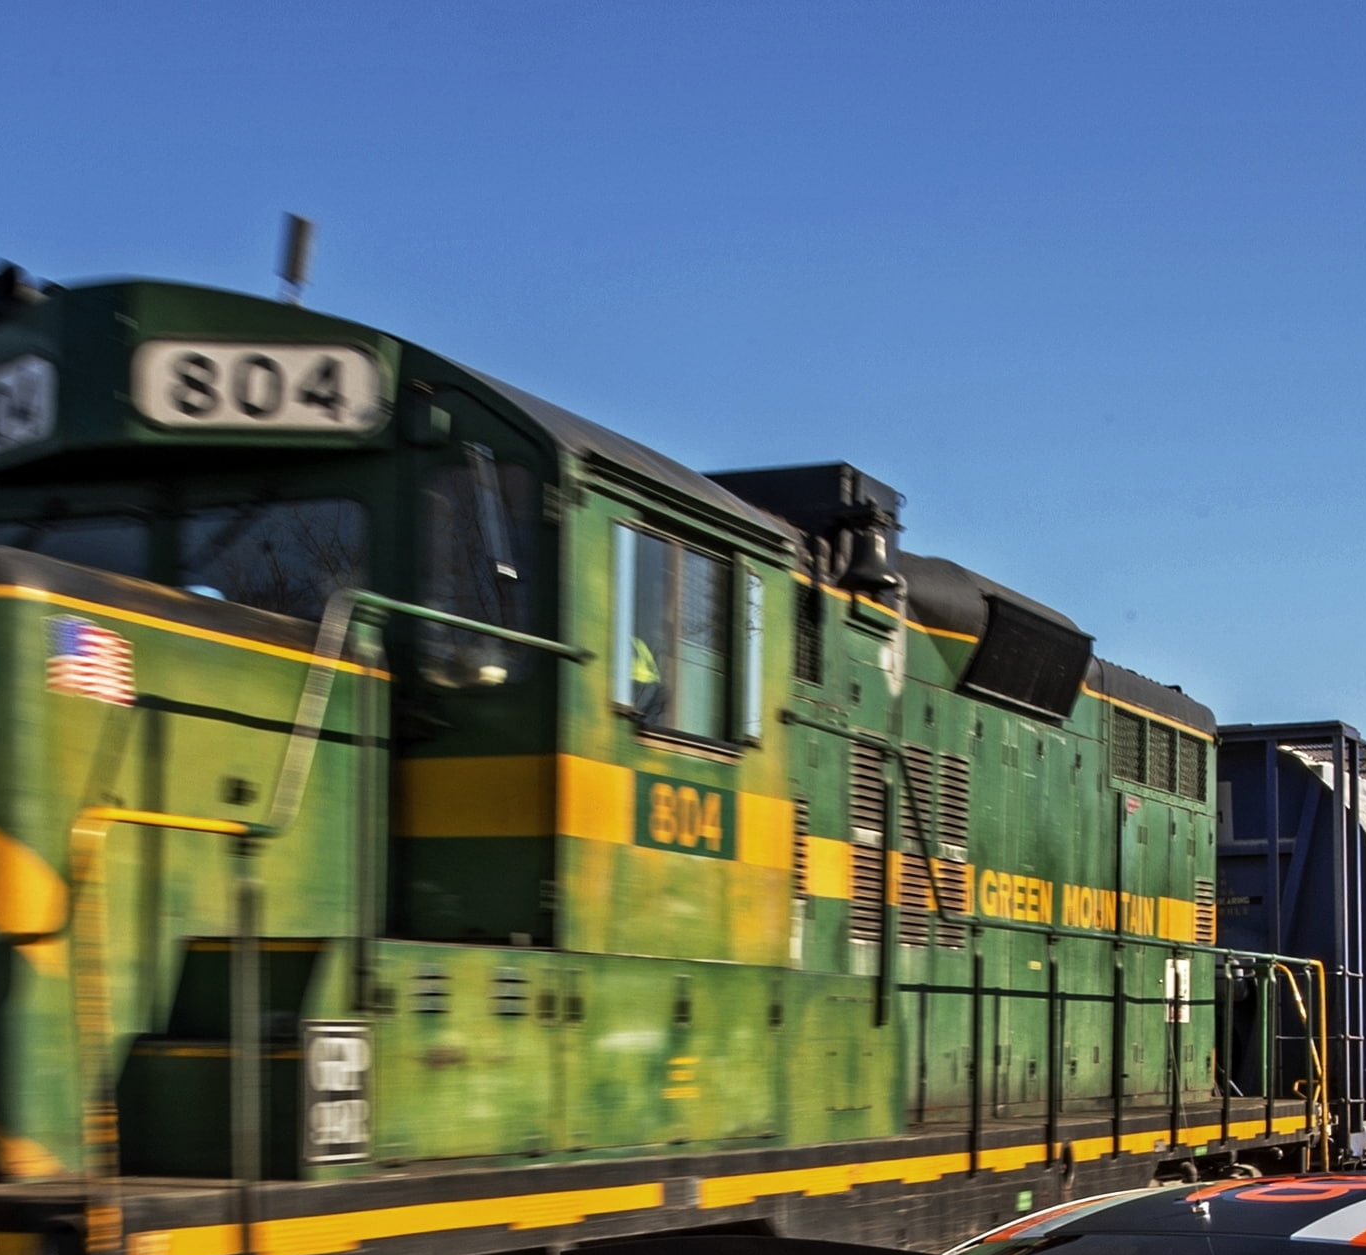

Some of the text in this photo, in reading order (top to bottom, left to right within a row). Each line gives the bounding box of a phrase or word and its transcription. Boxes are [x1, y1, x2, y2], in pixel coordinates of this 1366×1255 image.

[165, 350, 346, 424] 804
[649, 782, 724, 852] 804
[980, 869, 1156, 937] GREEN MOUNTAIN
